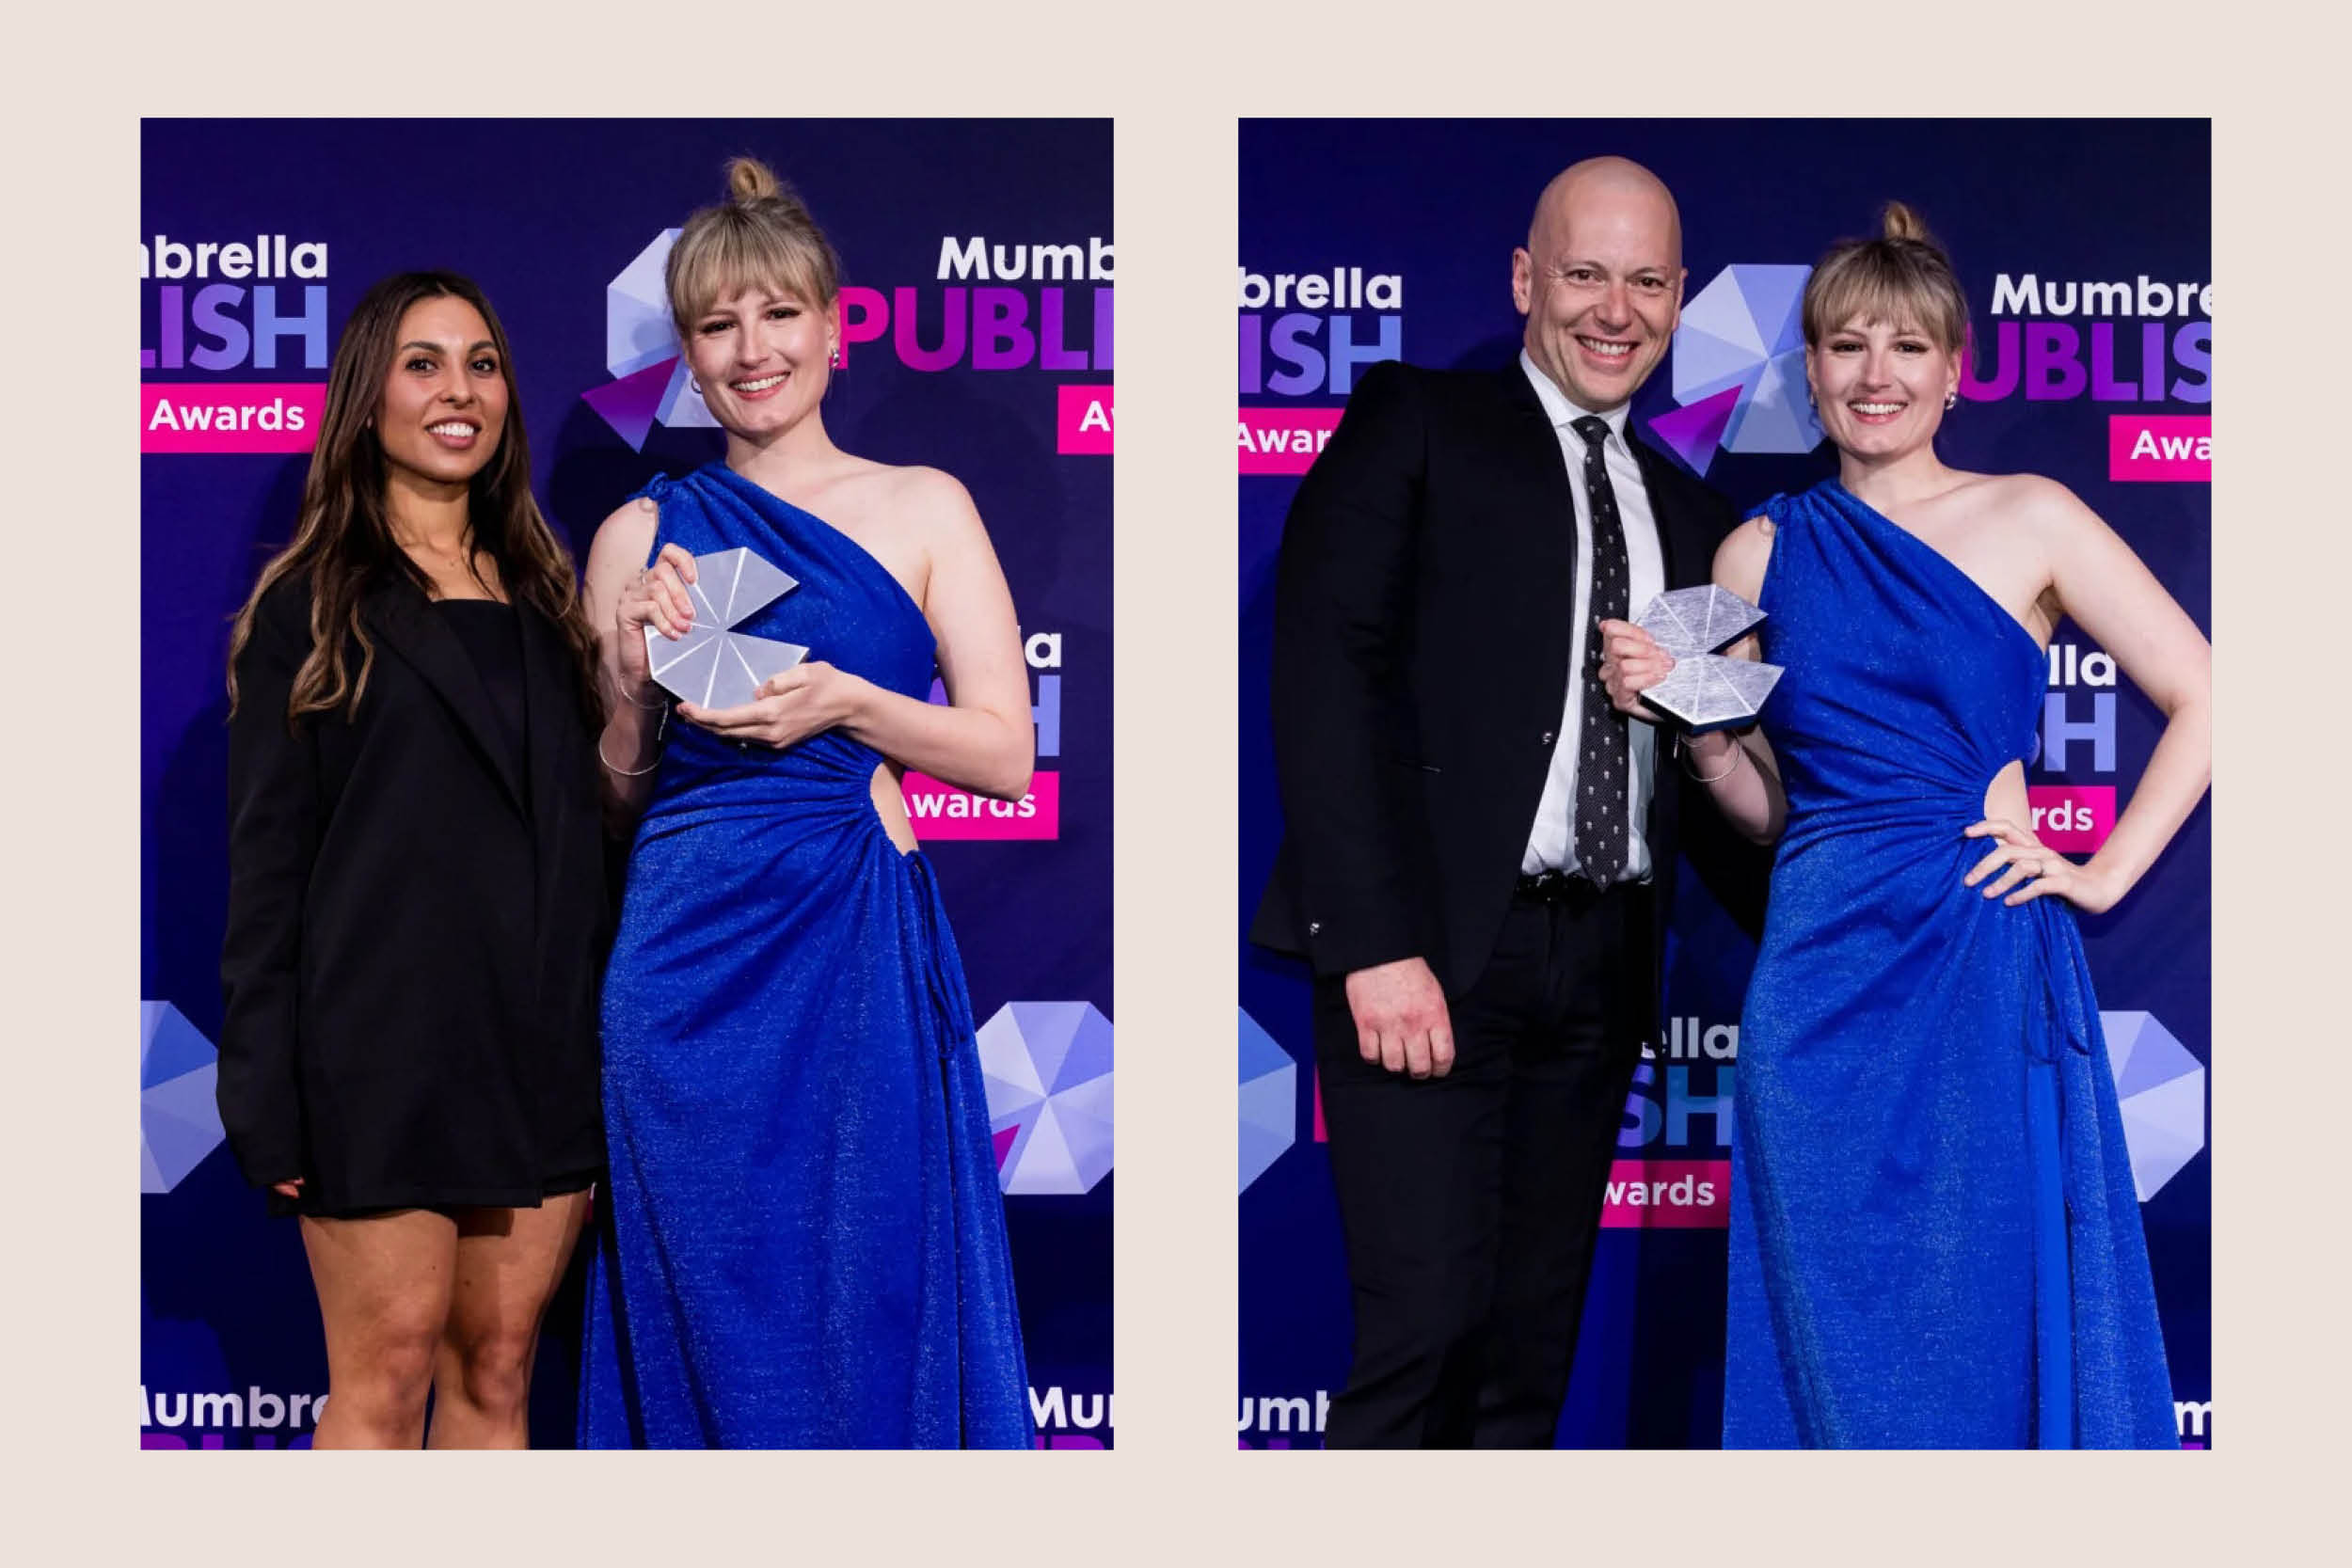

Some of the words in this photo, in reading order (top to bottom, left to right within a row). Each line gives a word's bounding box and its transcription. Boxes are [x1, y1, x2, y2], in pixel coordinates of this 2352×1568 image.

[140, 234, 327, 279] brella
[937, 236, 1114, 280] Mumb
[1238, 267, 1402, 309] brella
[140, 284, 327, 371] ISH
[149, 398, 305, 431] Awards
[1079, 401, 1114, 432] A
[2030, 692, 2116, 771] H
[140, 1385, 329, 1428] umbr
[1027, 1386, 1114, 1429] Mu
